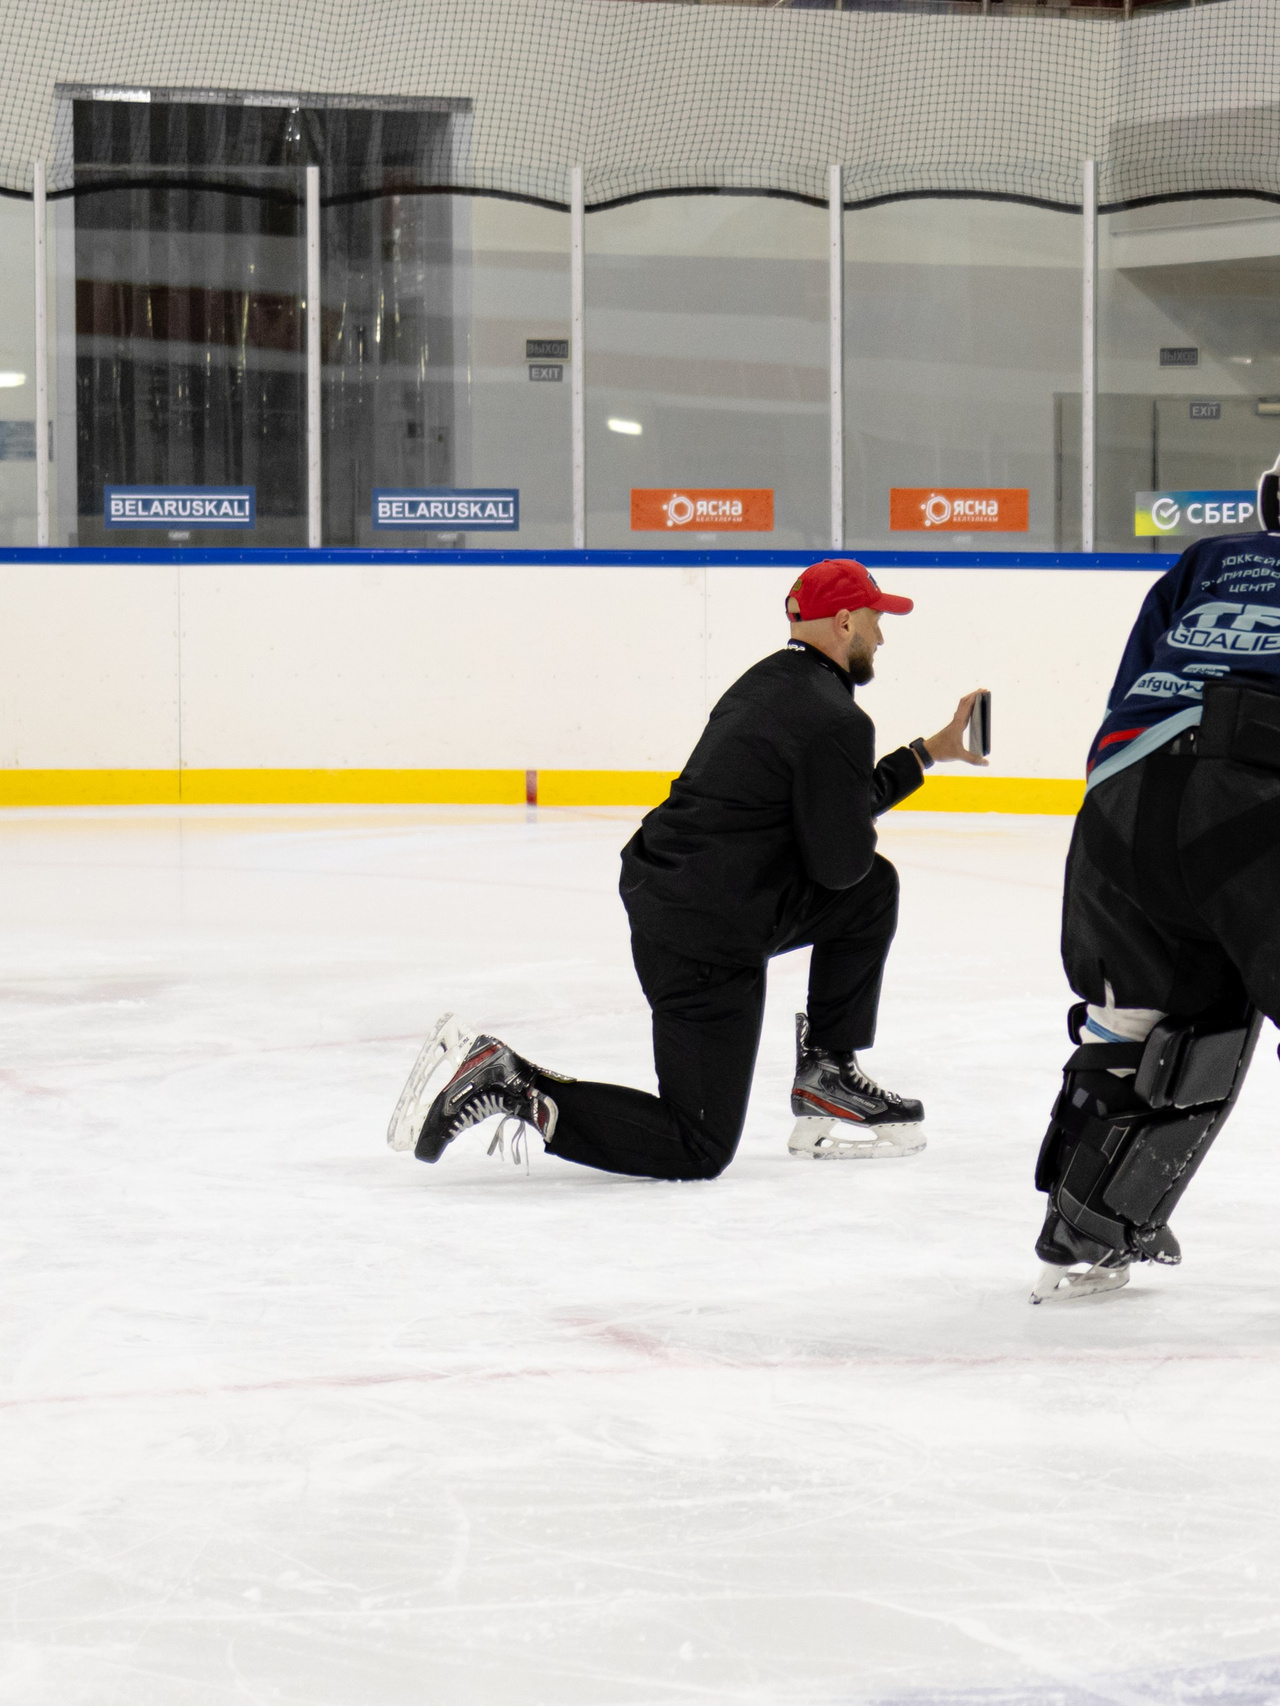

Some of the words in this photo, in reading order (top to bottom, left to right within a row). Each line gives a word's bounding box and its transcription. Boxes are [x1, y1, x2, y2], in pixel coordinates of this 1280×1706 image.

[531, 367, 560, 379] EXIT
[1192, 406, 1218, 416] EXIT
[111, 500, 250, 516] BELARUSKALI
[378, 502, 514, 518] BELARUSKALI
[1187, 503, 1254, 523] СБЕР
[1229, 582, 1276, 593] ЦЕНТР
